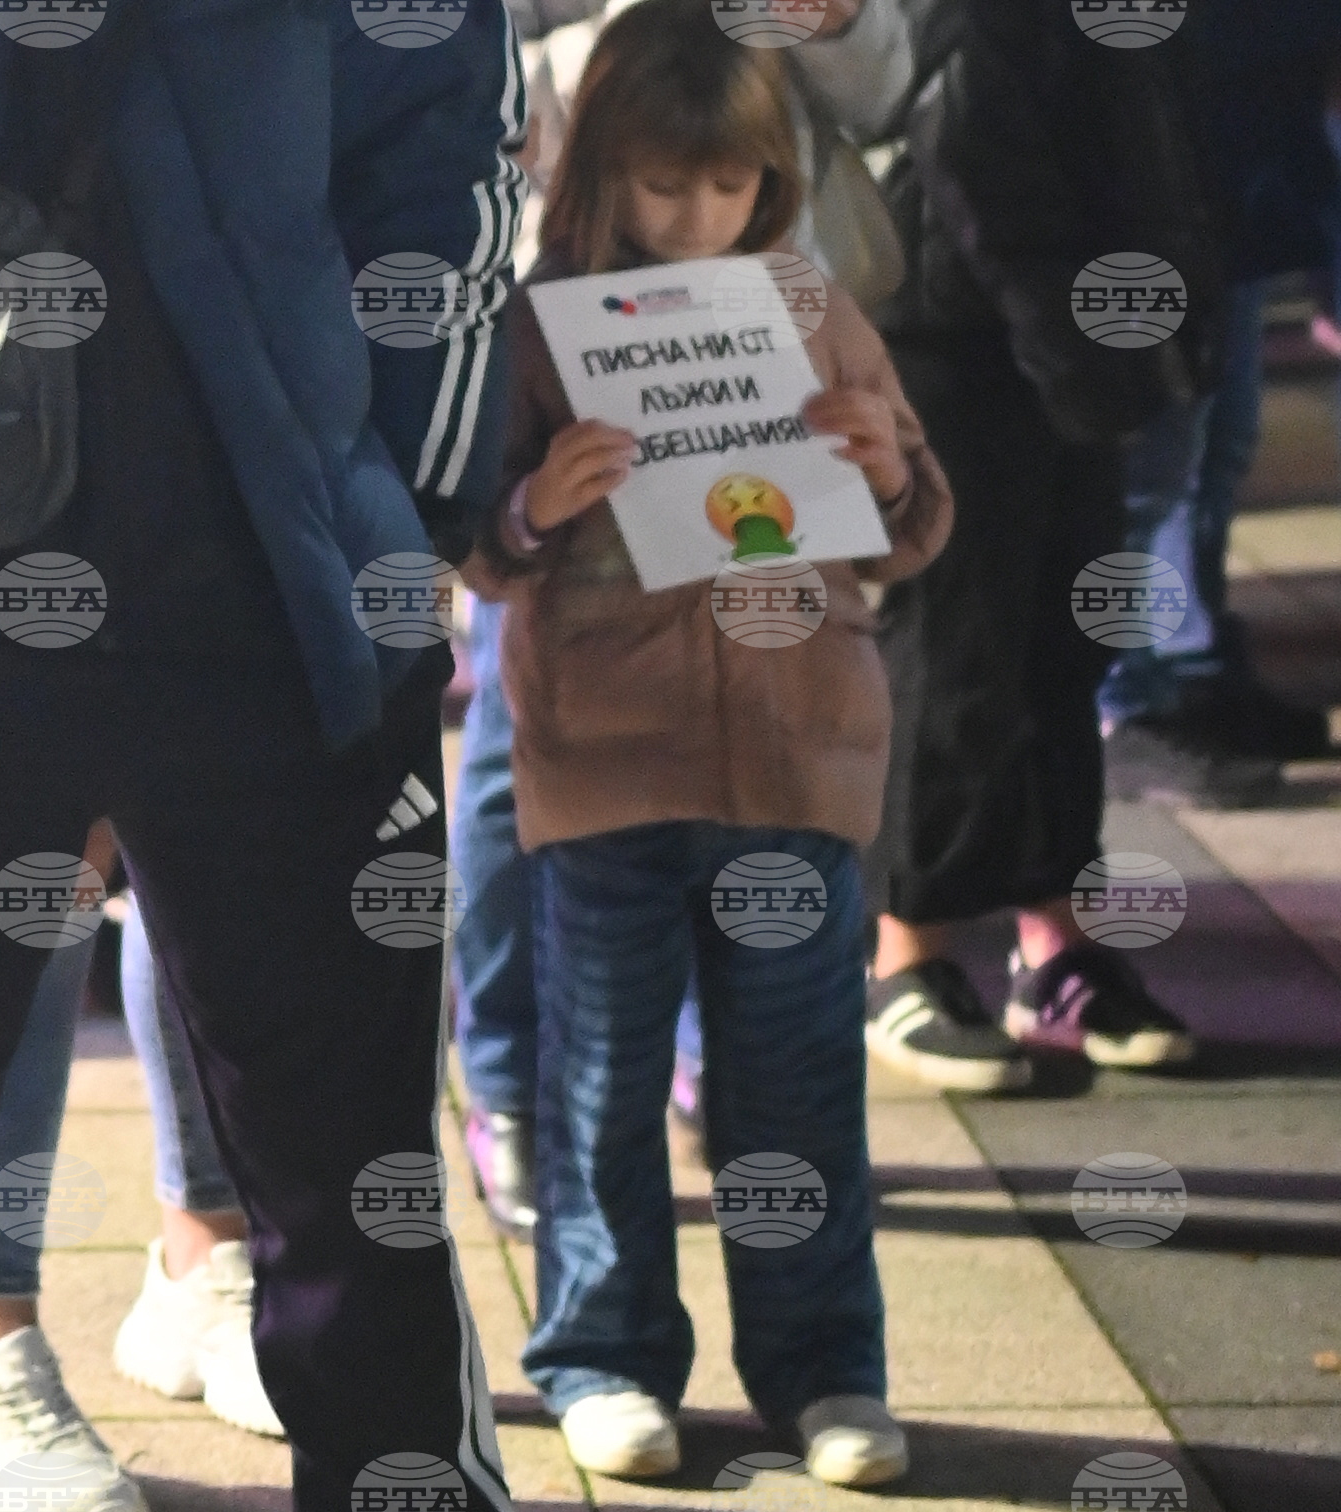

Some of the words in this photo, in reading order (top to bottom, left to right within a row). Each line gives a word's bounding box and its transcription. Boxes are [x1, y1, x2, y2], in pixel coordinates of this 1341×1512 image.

[581, 337, 690, 377] ПИСНА
[690, 331, 737, 361] НИ
[640, 379, 734, 416] ЛЪЖИ
[736, 375, 762, 402] И
